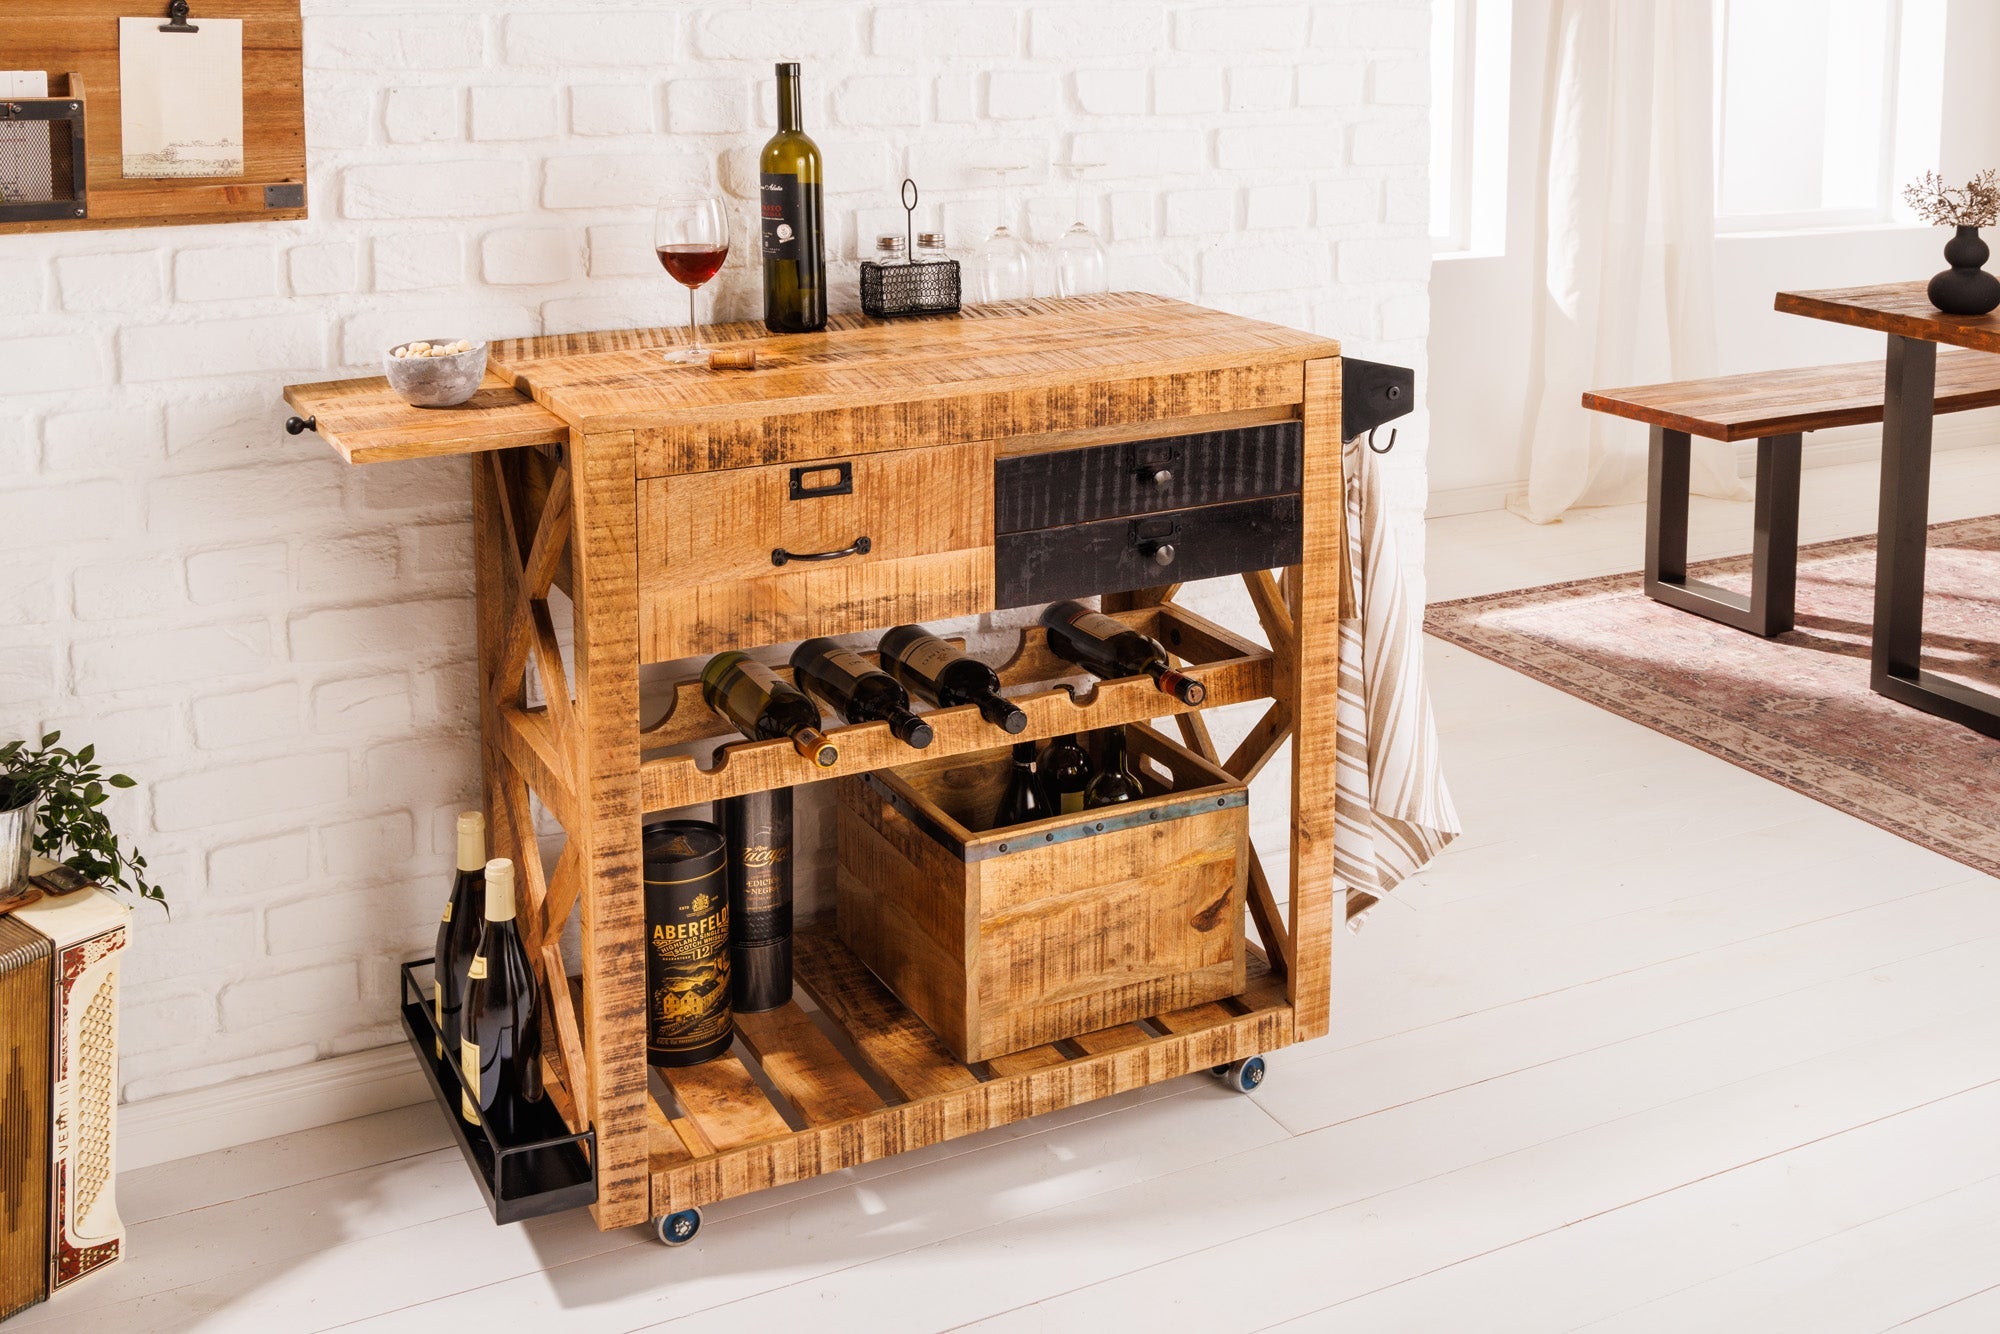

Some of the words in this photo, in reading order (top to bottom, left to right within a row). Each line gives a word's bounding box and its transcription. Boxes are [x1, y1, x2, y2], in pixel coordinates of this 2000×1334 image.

[661, 936, 698, 954] HIGHLAND
[699, 928, 721, 941] SINGLE
[674, 940, 703, 955] SCOTCH
[696, 945, 710, 960] 12
